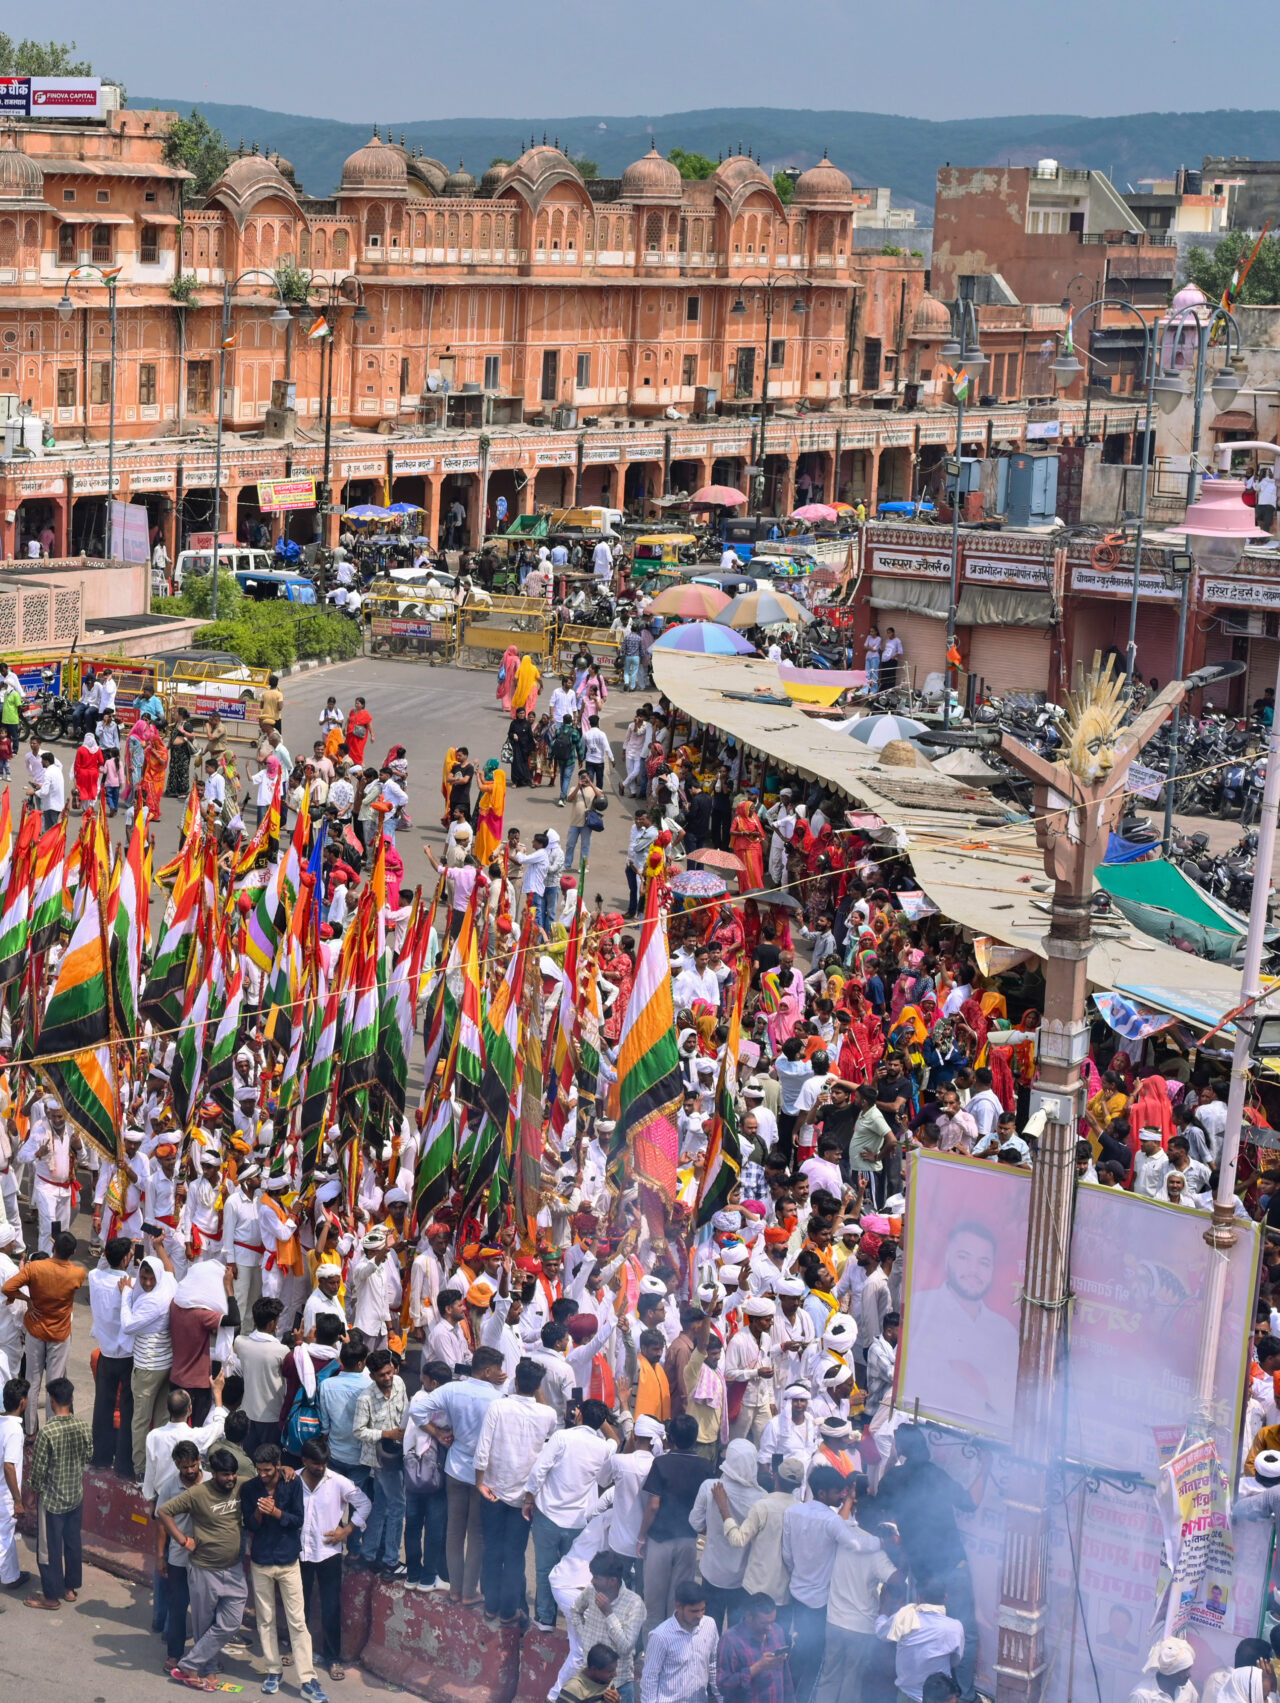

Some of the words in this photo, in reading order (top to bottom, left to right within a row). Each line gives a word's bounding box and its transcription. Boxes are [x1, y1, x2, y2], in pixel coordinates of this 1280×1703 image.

[8, 80, 28, 95] चौक
[879, 557, 912, 570] परम्परा
[915, 558, 942, 573] ज्वैलर्स
[1207, 585, 1228, 598] सुरेश
[1230, 585, 1253, 598] ट्रेडर्स
